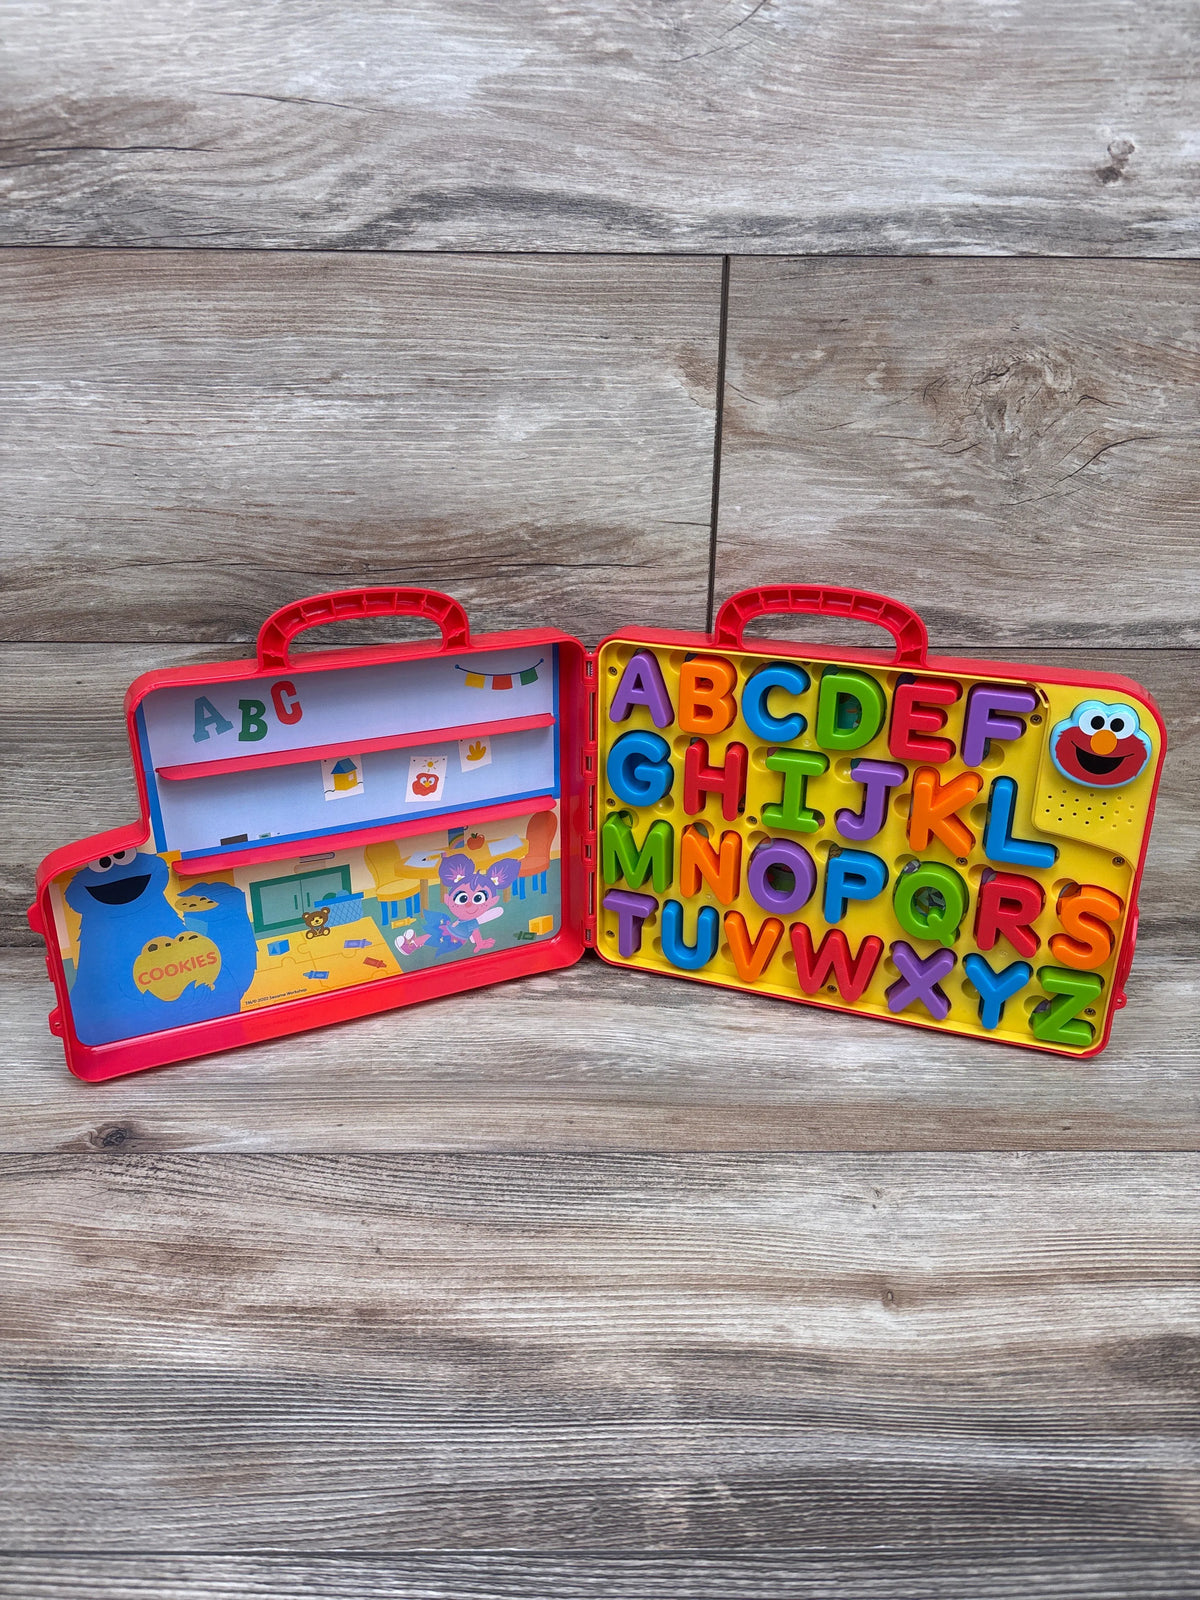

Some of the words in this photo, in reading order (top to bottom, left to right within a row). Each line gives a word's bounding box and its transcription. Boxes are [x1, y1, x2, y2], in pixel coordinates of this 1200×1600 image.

[138, 951, 218, 986] COOKIES
[269, 992, 286, 1000] Sesame
[286, 988, 308, 997] Workshop
